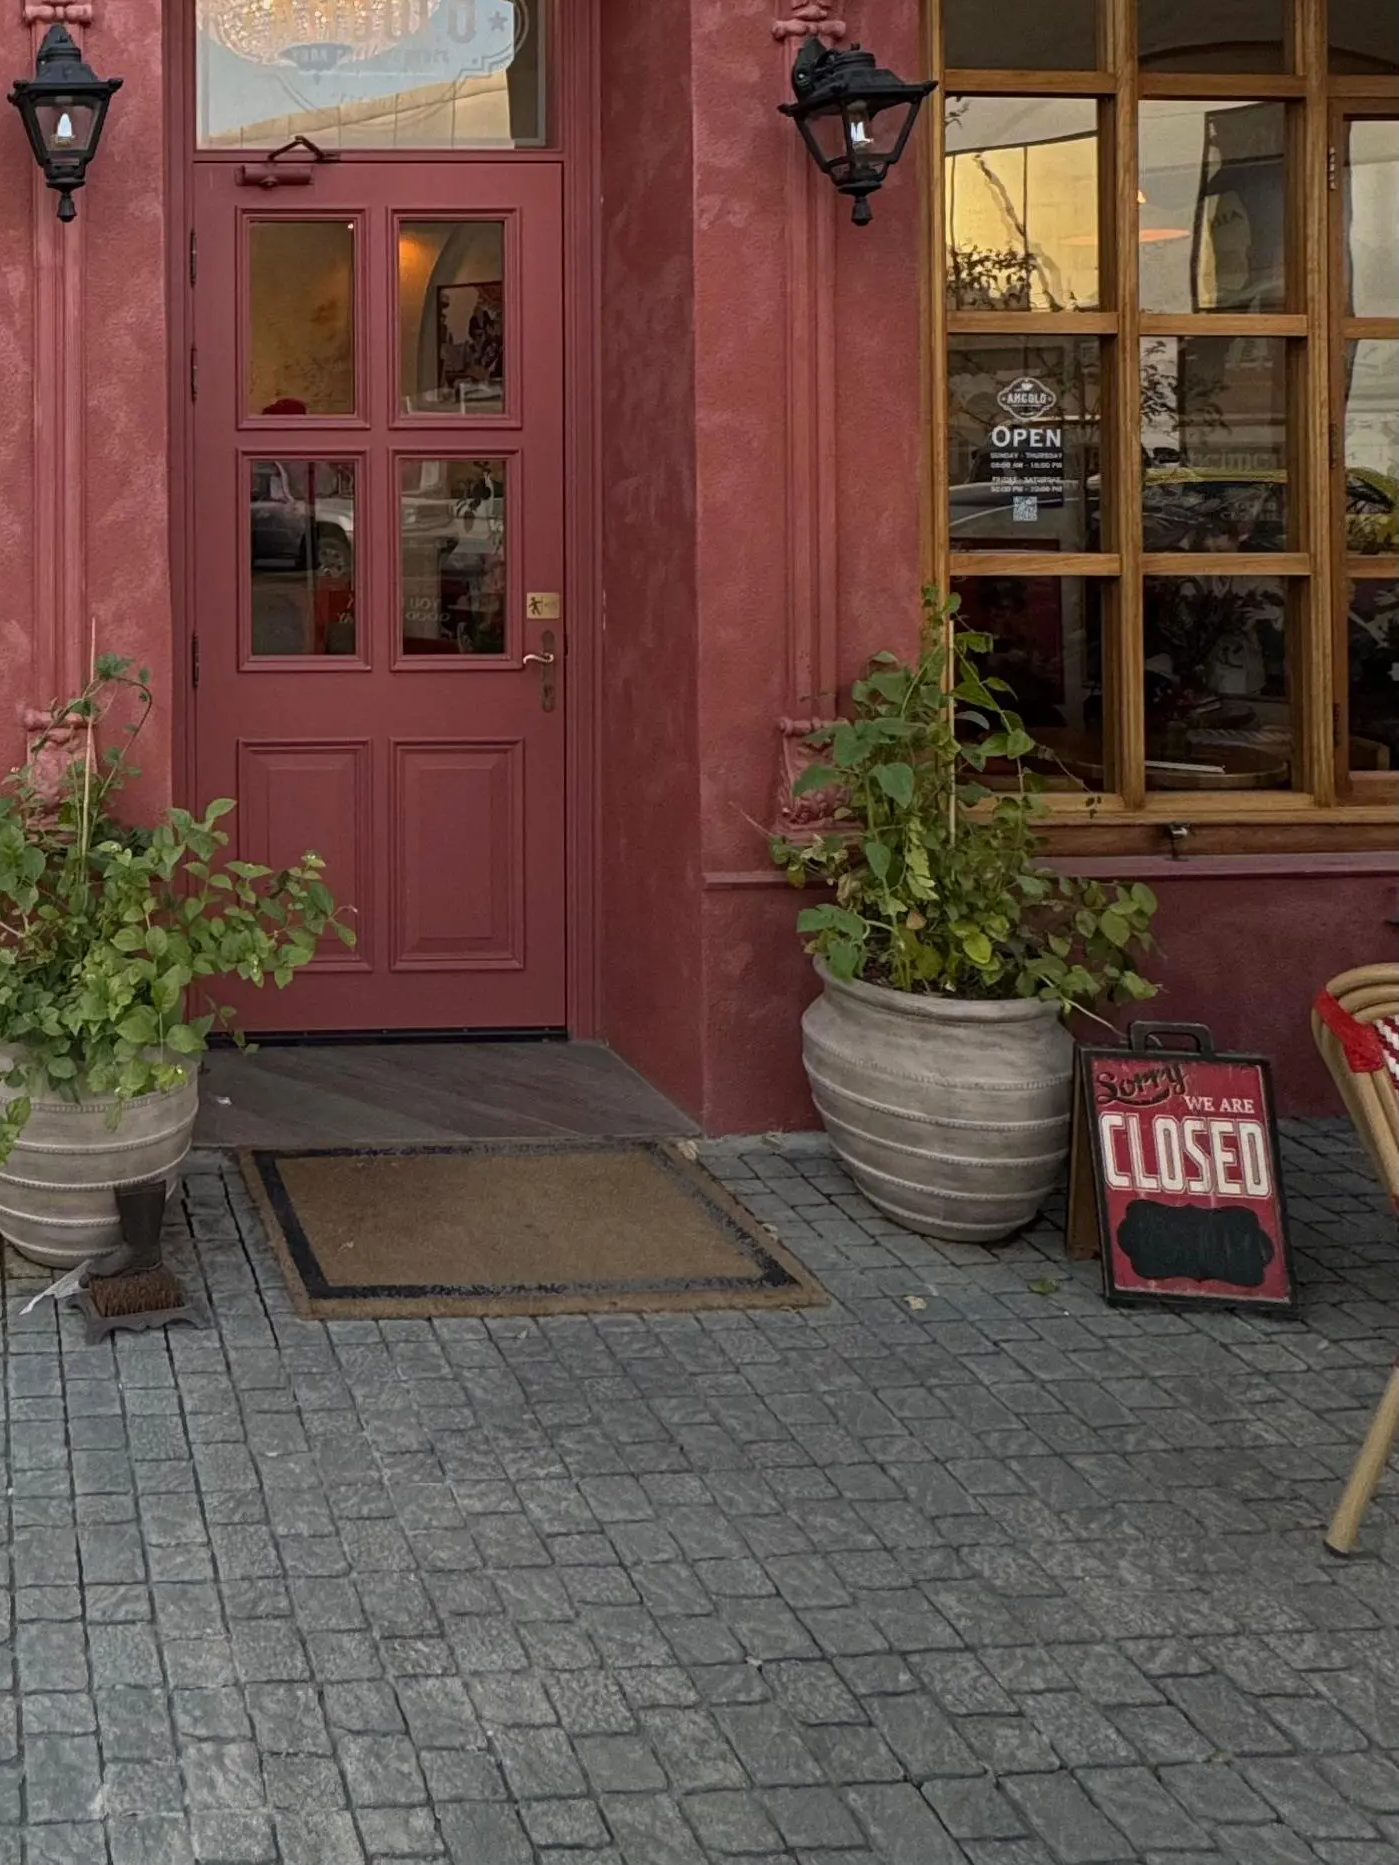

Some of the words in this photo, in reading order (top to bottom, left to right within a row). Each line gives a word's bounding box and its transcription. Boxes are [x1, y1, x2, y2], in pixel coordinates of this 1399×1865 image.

[991, 425, 1061, 448] OPEN
[1097, 1063, 1188, 1108] Sorry
[1184, 1095, 1215, 1113] WE
[1220, 1098, 1255, 1114] ARE
[1099, 1112, 1271, 1199] CLOSED
